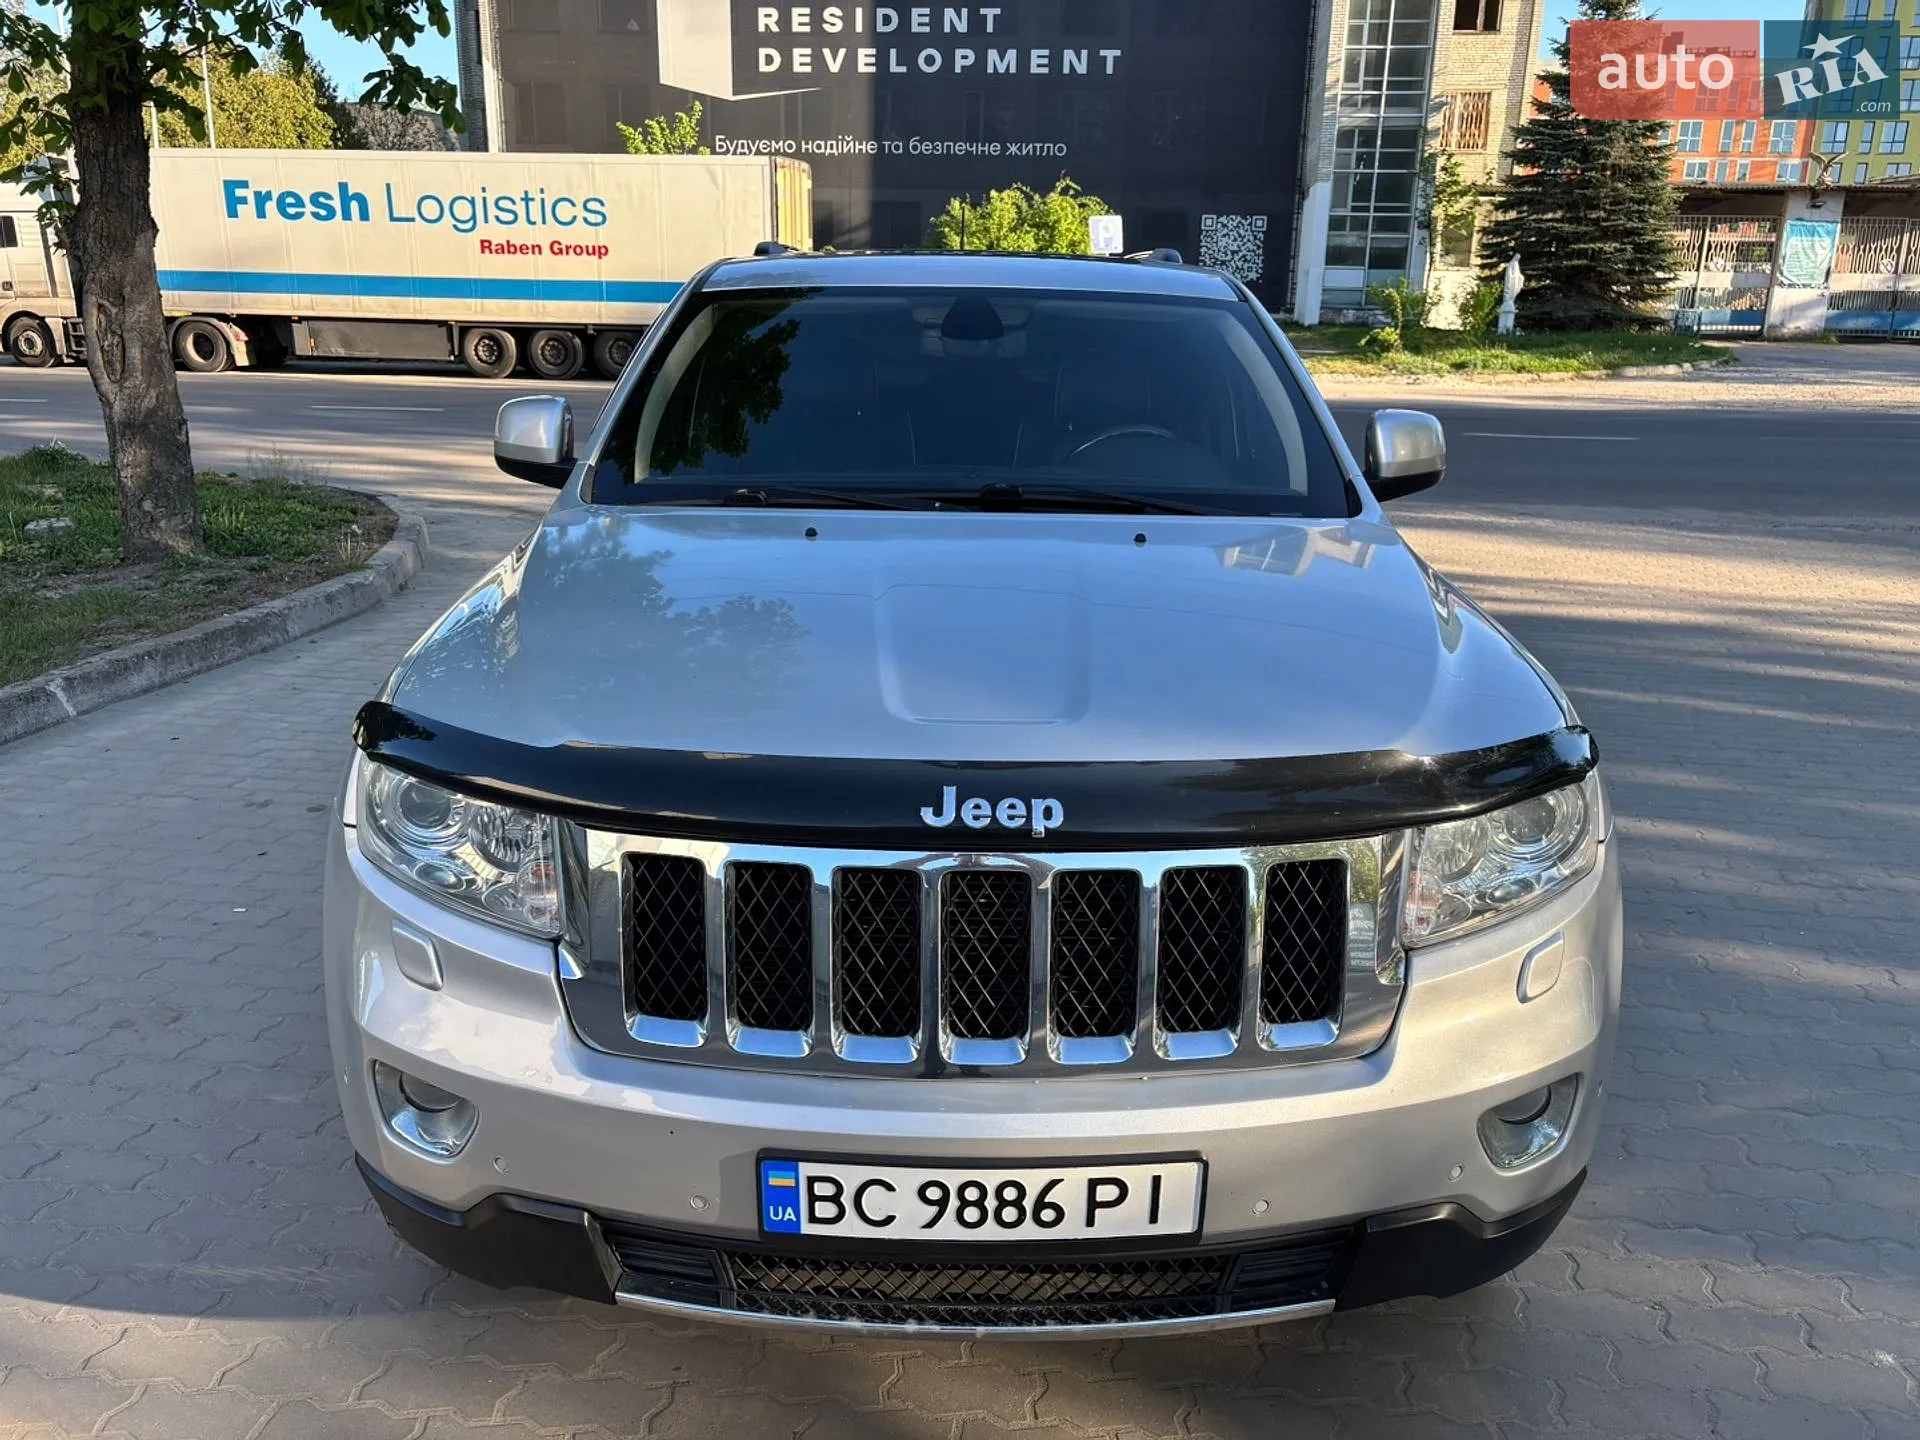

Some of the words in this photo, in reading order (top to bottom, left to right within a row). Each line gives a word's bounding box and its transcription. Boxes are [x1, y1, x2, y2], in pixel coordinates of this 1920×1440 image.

[757, 7, 1003, 33] RESIDENT
[758, 47, 1122, 74] DEVELOPMENT
[715, 135, 796, 156] Будуємо
[801, 137, 878, 155] надійне
[883, 139, 904, 154] та
[909, 138, 1001, 155] безпечне
[1005, 139, 1067, 157] житло
[223, 179, 370, 222] Fresh
[385, 183, 608, 233] Logistics
[480, 239, 543, 257] Raben
[549, 240, 609, 259] Group
[920, 785, 1064, 837] Jeep
[769, 1206, 797, 1222] UA
[917, 1178, 1066, 1230] 9886
